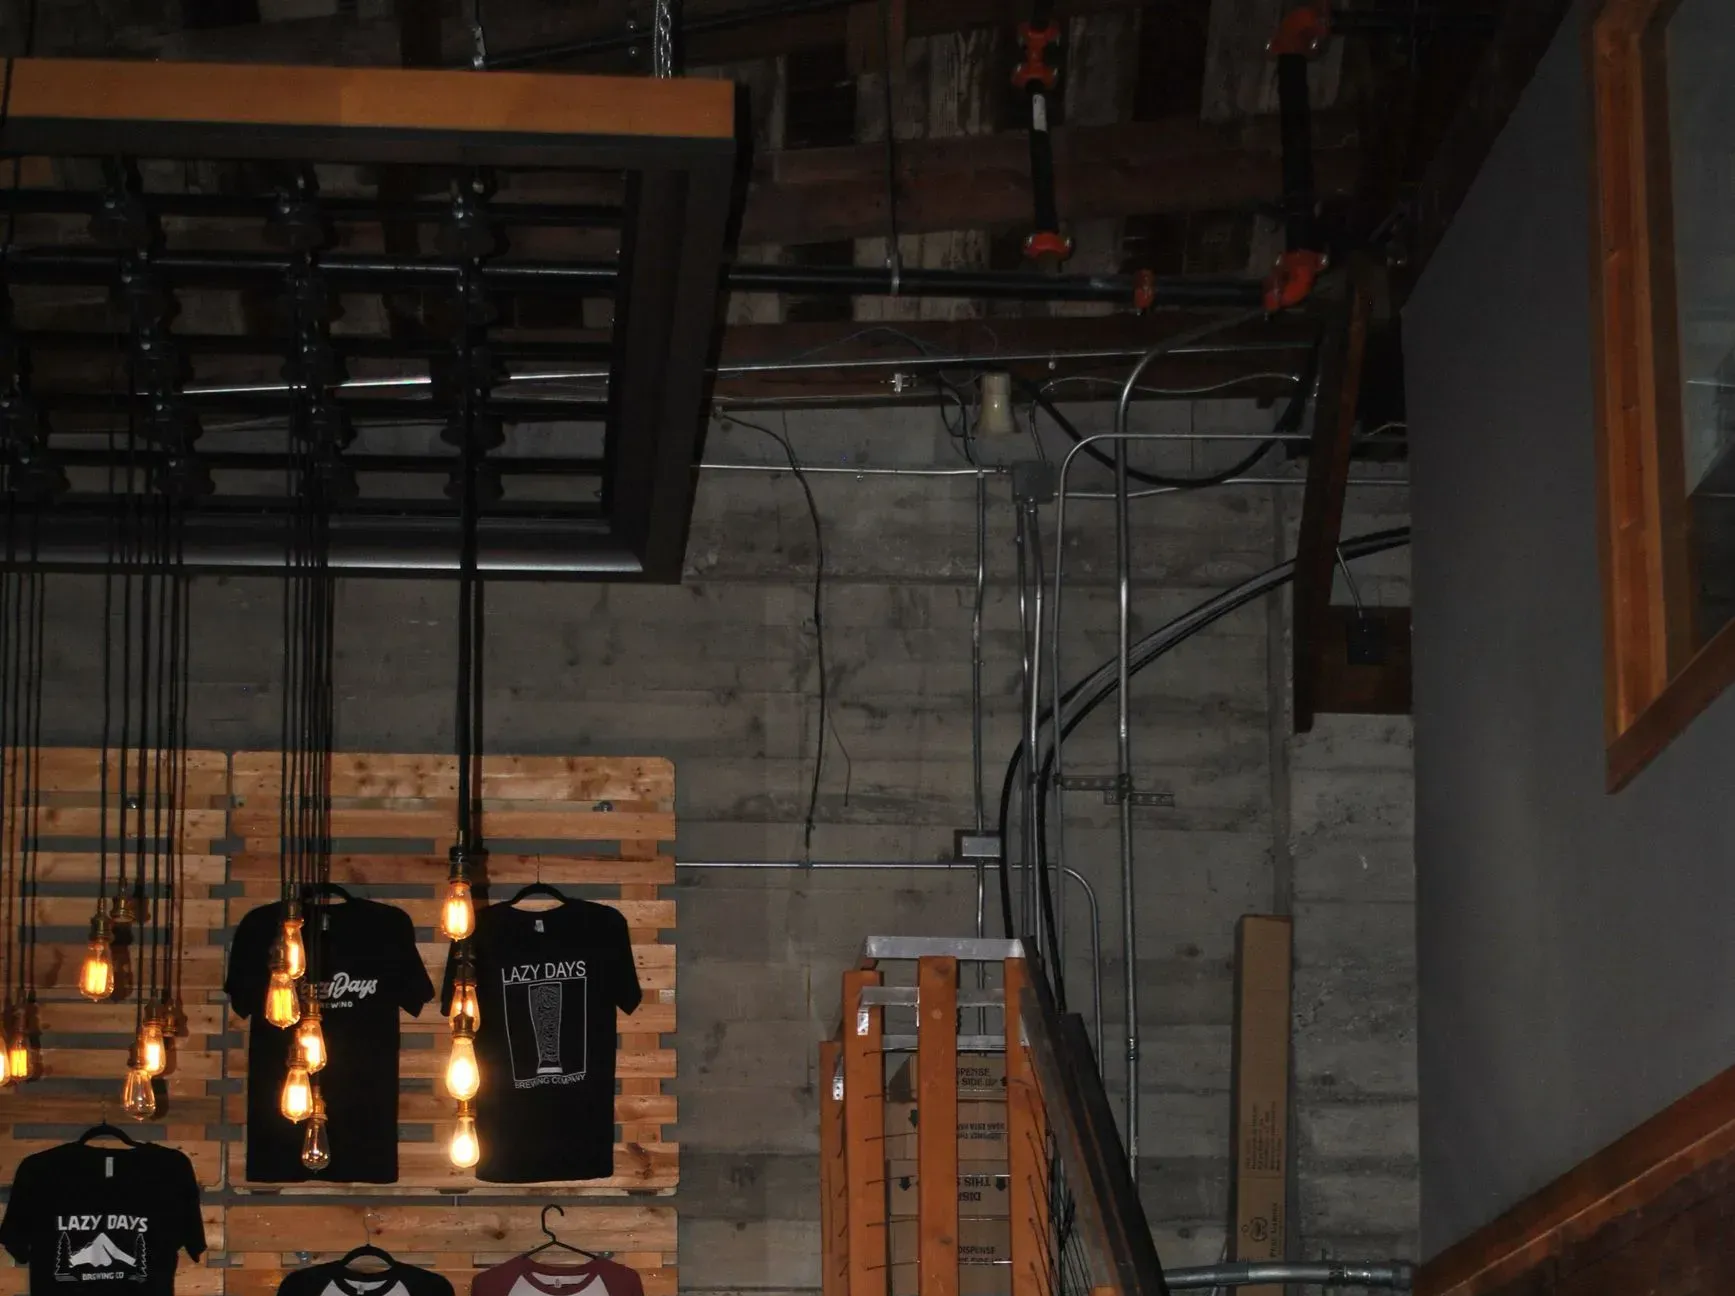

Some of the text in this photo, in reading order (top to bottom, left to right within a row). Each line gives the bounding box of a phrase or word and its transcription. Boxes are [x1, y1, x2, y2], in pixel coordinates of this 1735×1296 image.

[501, 960, 586, 983] LAZY DAYS
[58, 1214, 148, 1233] LAZY DAYS
